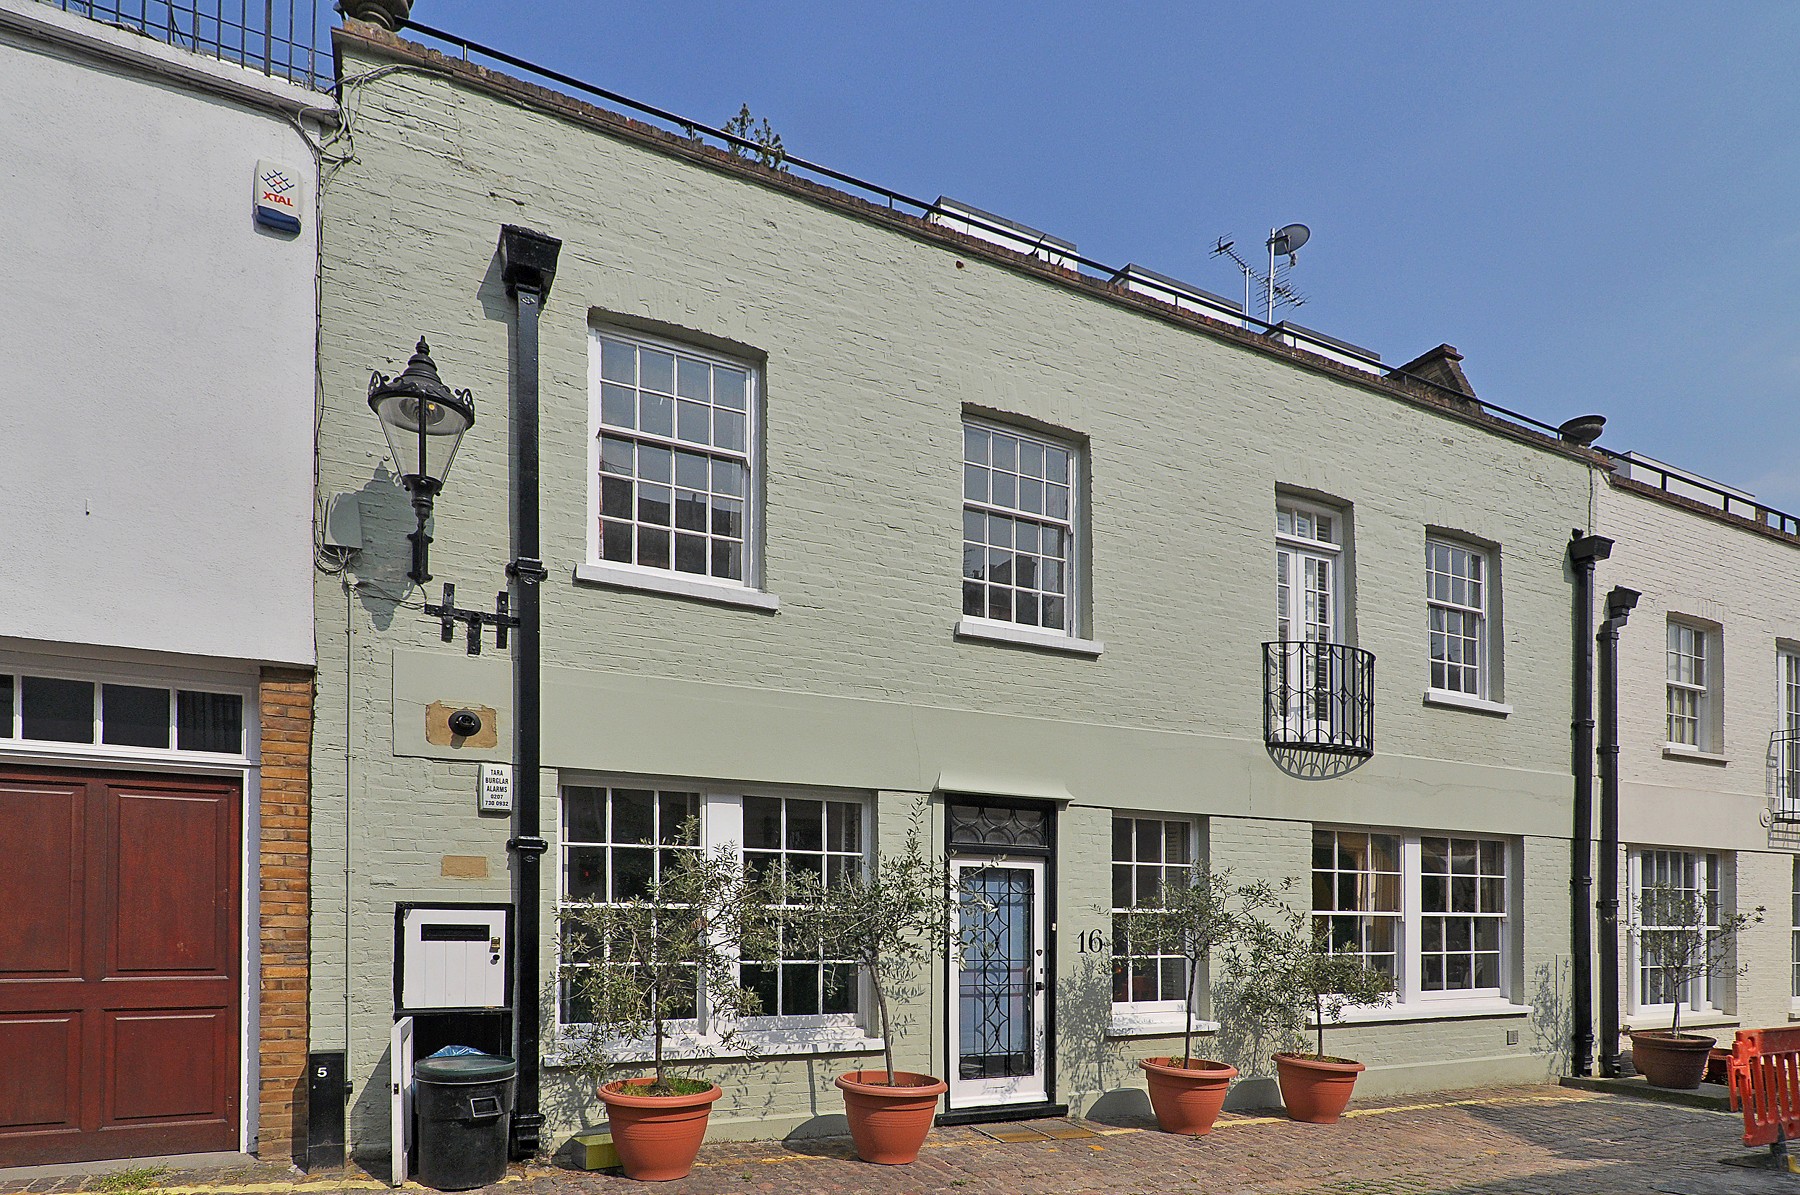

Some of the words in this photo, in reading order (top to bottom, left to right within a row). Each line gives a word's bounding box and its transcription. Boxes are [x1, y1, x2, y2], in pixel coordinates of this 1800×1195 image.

[263, 191, 294, 207] XTAL
[486, 785, 508, 793] ALARMS
[1077, 928, 1103, 953] 16
[317, 1066, 328, 1078] 5
